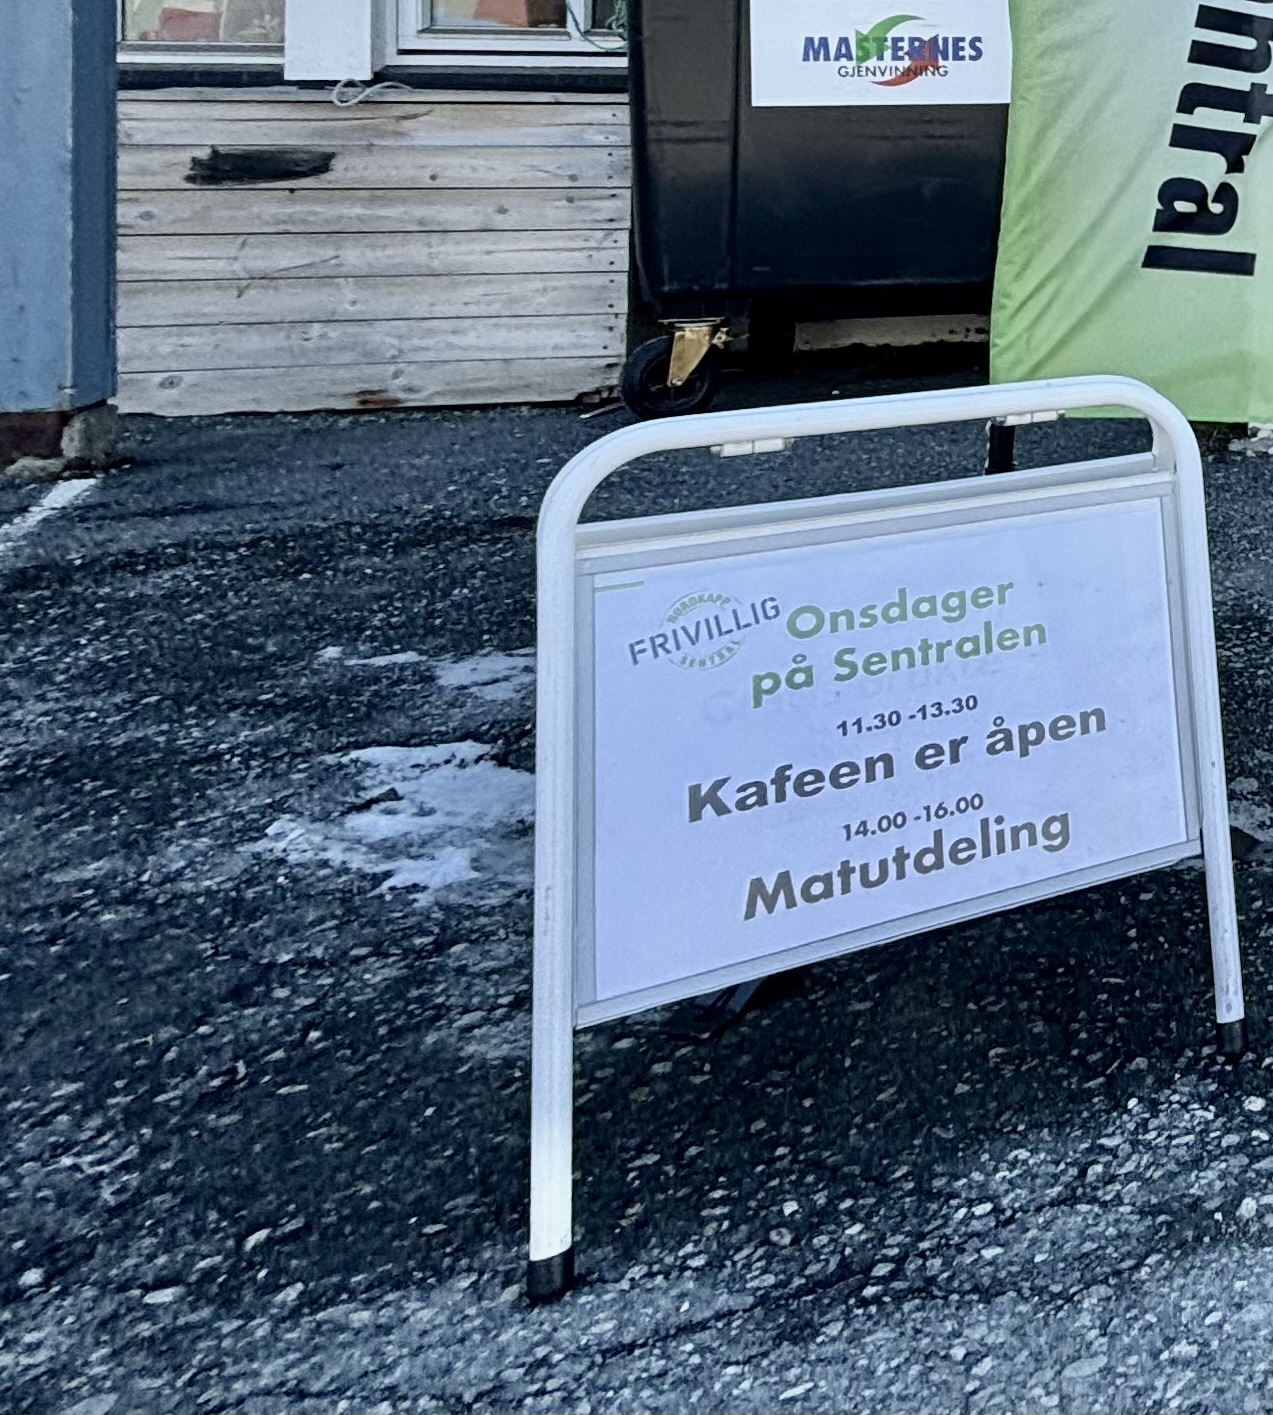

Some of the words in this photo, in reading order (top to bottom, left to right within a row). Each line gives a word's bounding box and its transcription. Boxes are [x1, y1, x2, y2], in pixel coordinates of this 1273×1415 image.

[802, 36, 983, 62] MASTERNES
[838, 65, 949, 78] GJENVINNING
[629, 596, 781, 666] FRIVILLIG
[786, 582, 1014, 639] Onsdager
[752, 653, 814, 709] på
[833, 620, 1047, 682] Sentralen
[836, 709, 902, 737] 11.30
[688, 752, 895, 823] Kafeen
[914, 735, 969, 771] er
[985, 707, 1107, 758] åpen
[842, 811, 907, 842] 14.00
[743, 812, 1071, 922] Matutdeling
